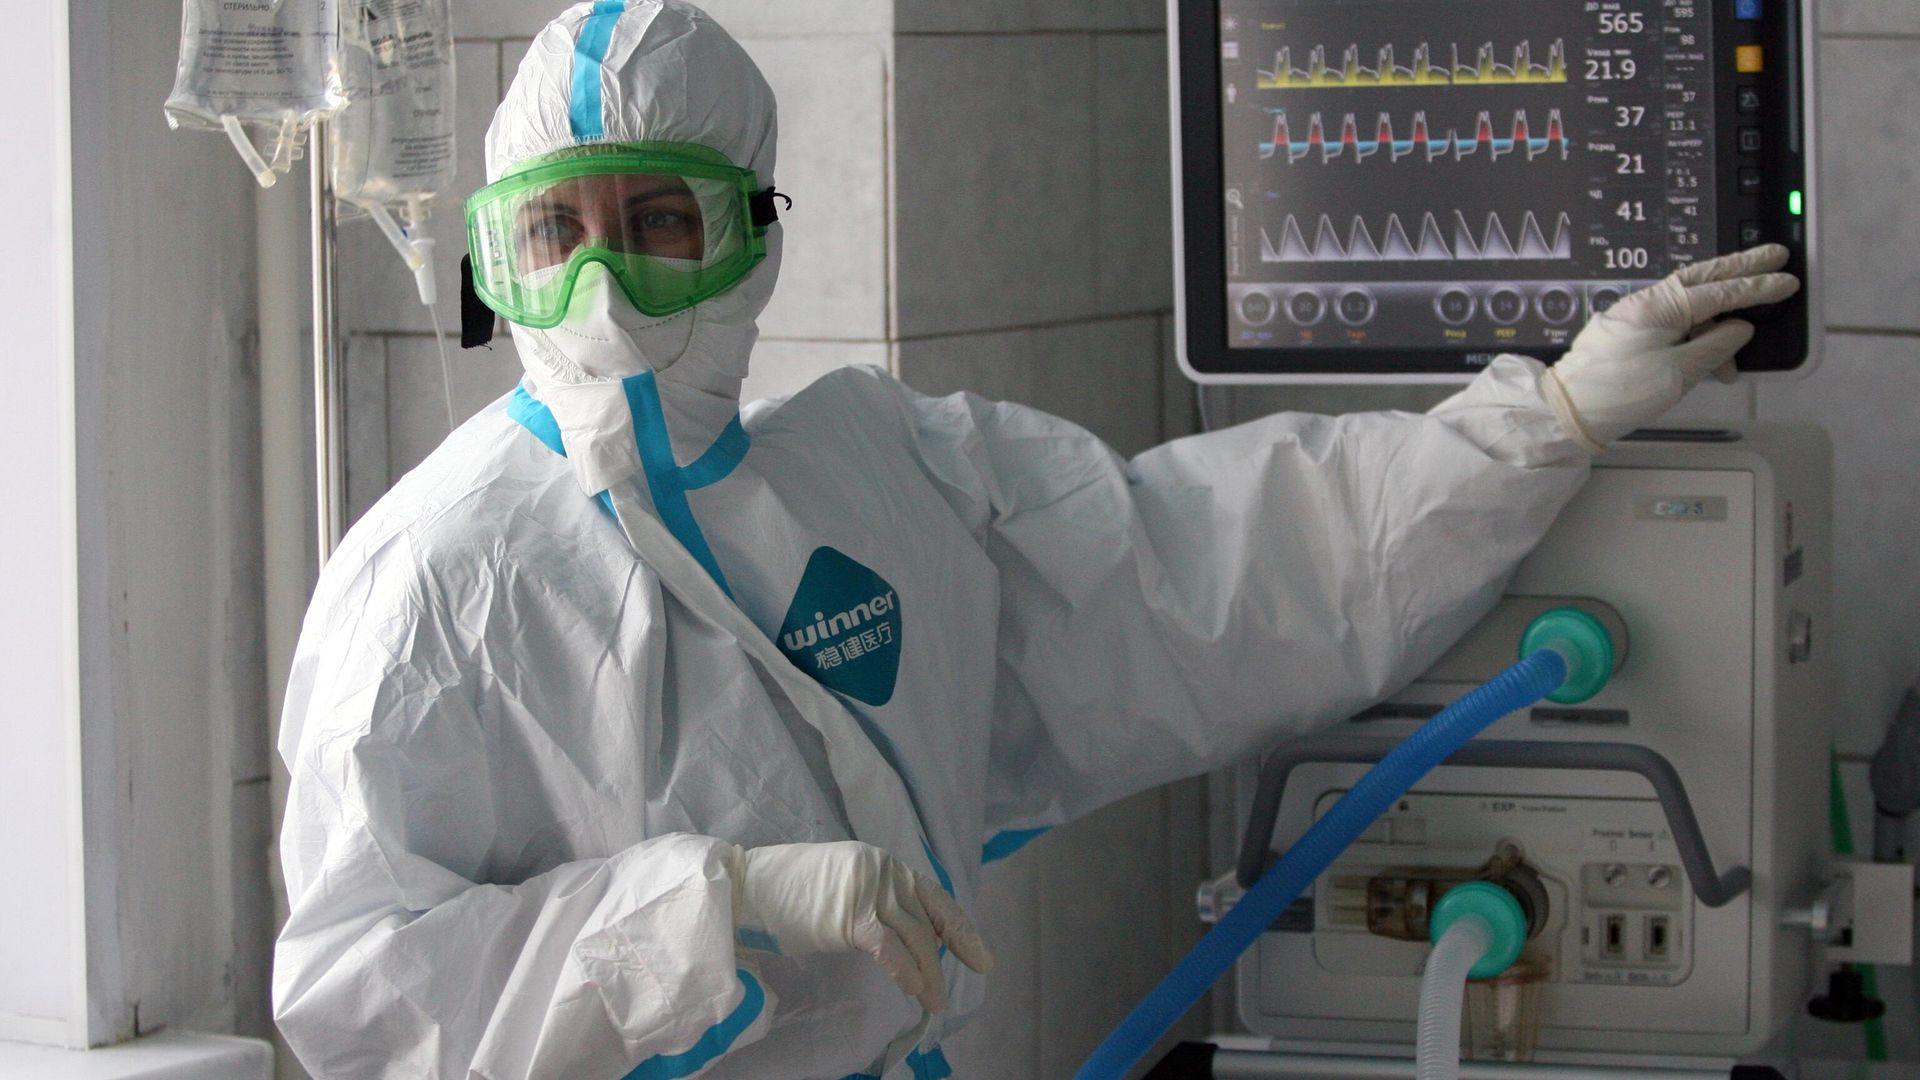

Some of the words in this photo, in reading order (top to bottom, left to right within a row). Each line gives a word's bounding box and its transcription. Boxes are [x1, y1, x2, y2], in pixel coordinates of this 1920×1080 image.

[1599, 12, 1644, 34] 565
[1585, 59, 1636, 80] 21.9
[1616, 106, 1645, 127] 37
[1616, 153, 1646, 174] 21
[1616, 201, 1646, 221] 41
[1604, 247, 1648, 269] 100
[784, 590, 894, 651] winner
[814, 621, 893, 671] 稳健医疗
